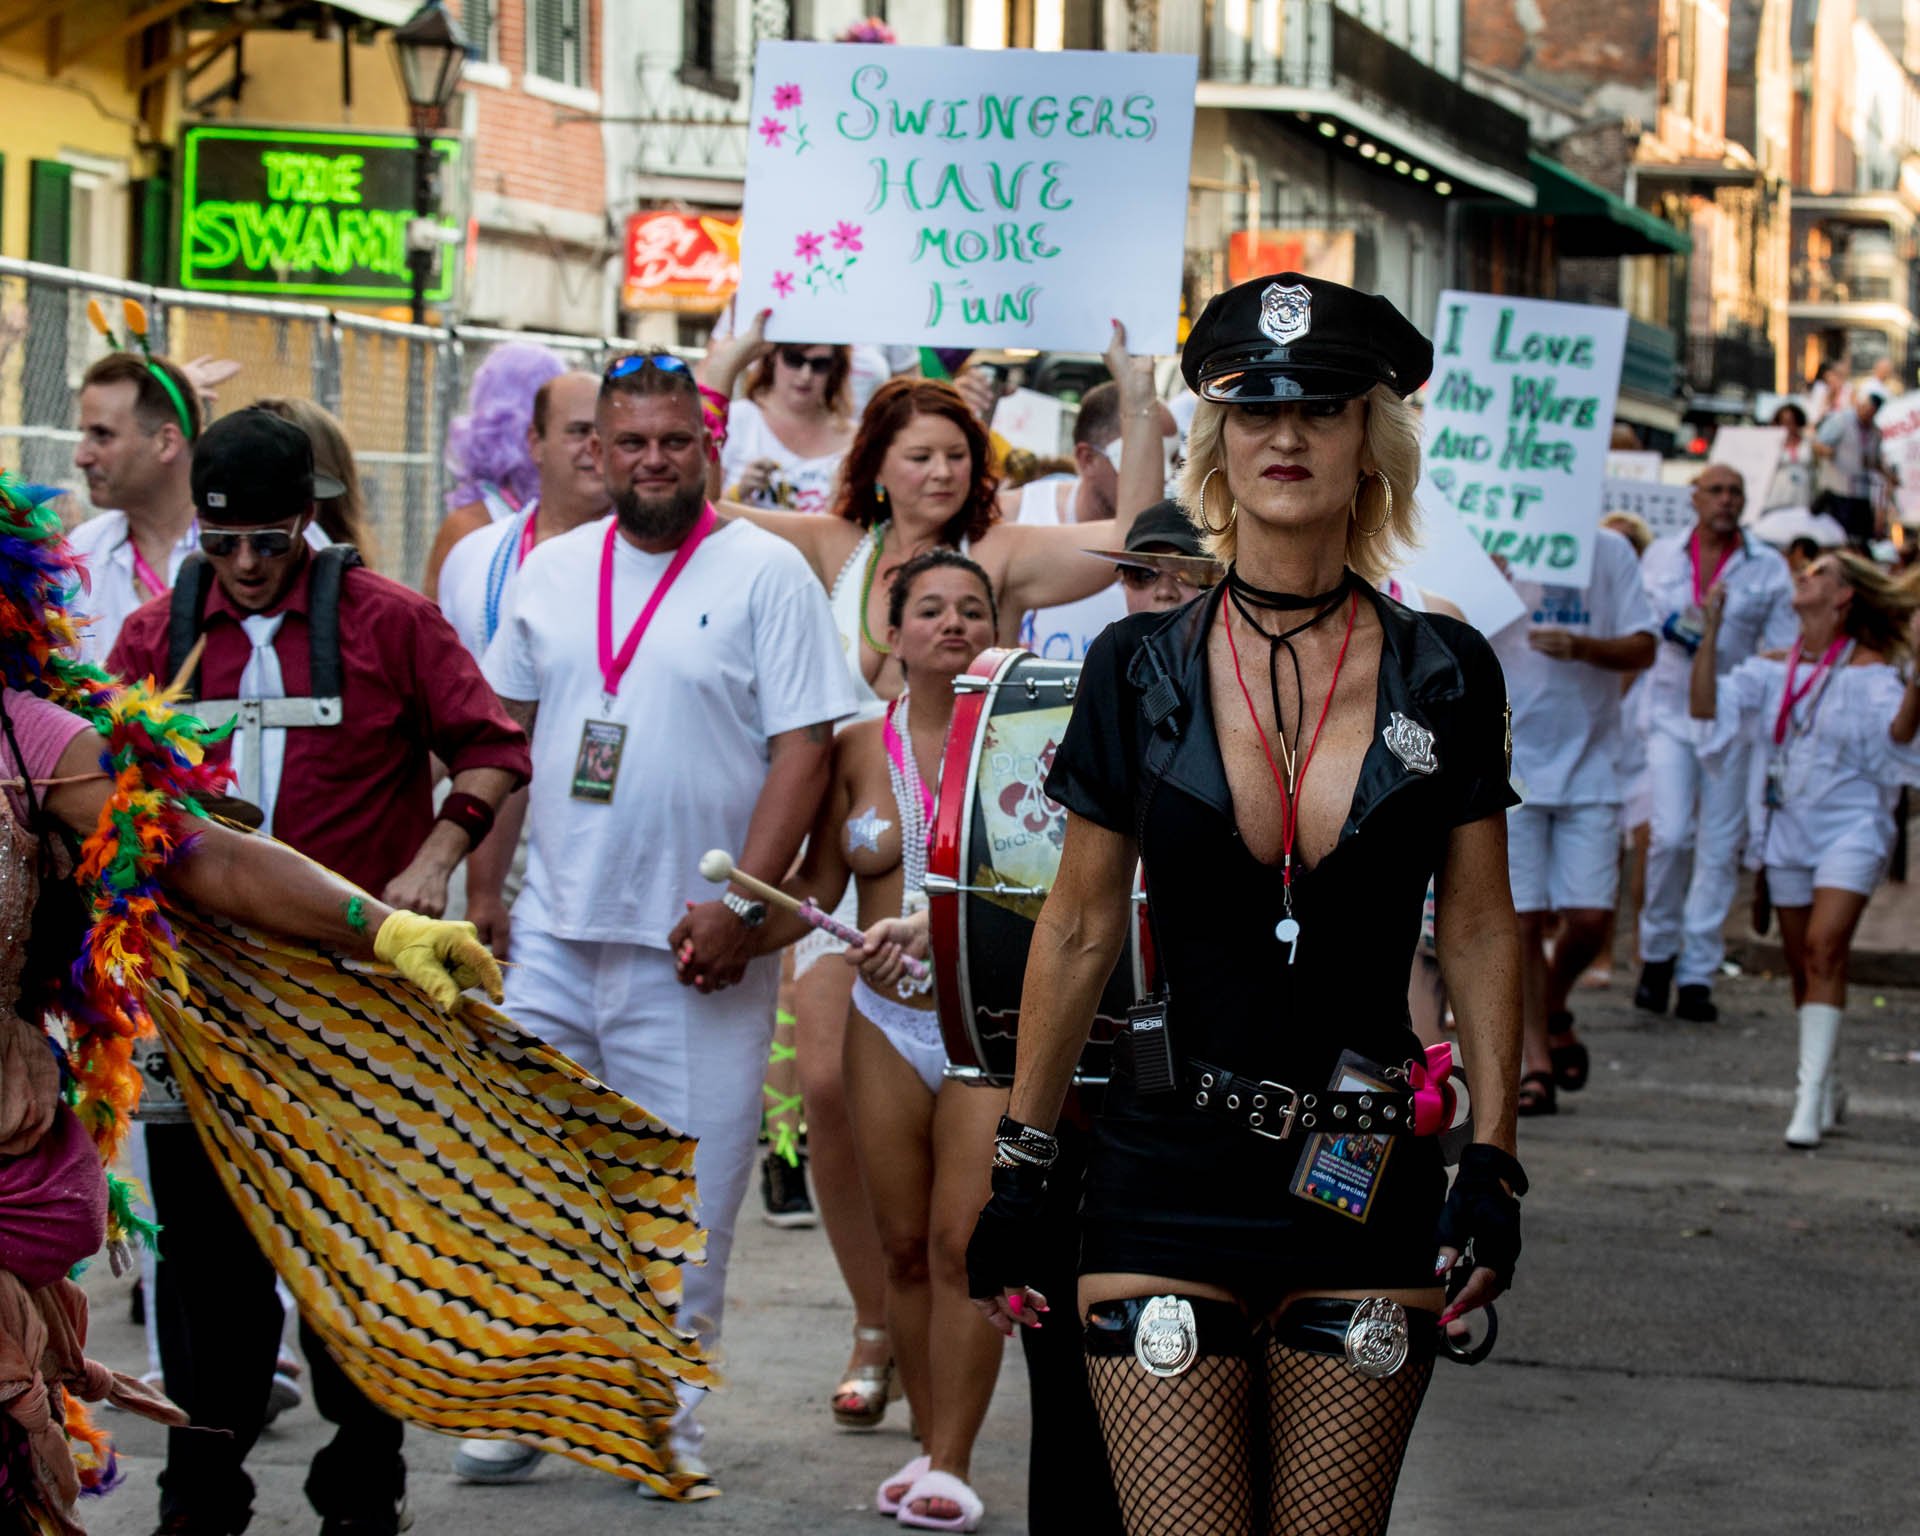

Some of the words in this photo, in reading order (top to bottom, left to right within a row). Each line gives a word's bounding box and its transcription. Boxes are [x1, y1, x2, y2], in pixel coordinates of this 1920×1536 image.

[866, 157, 1075, 214] HAVE
[910, 222, 1062, 269] MORE
[1441, 303, 1469, 358] I
[1429, 425, 1492, 463] AND
[1498, 425, 1577, 475] HER
[1311, 1169, 1337, 1184] colette
[1337, 1181, 1368, 1200] specials
